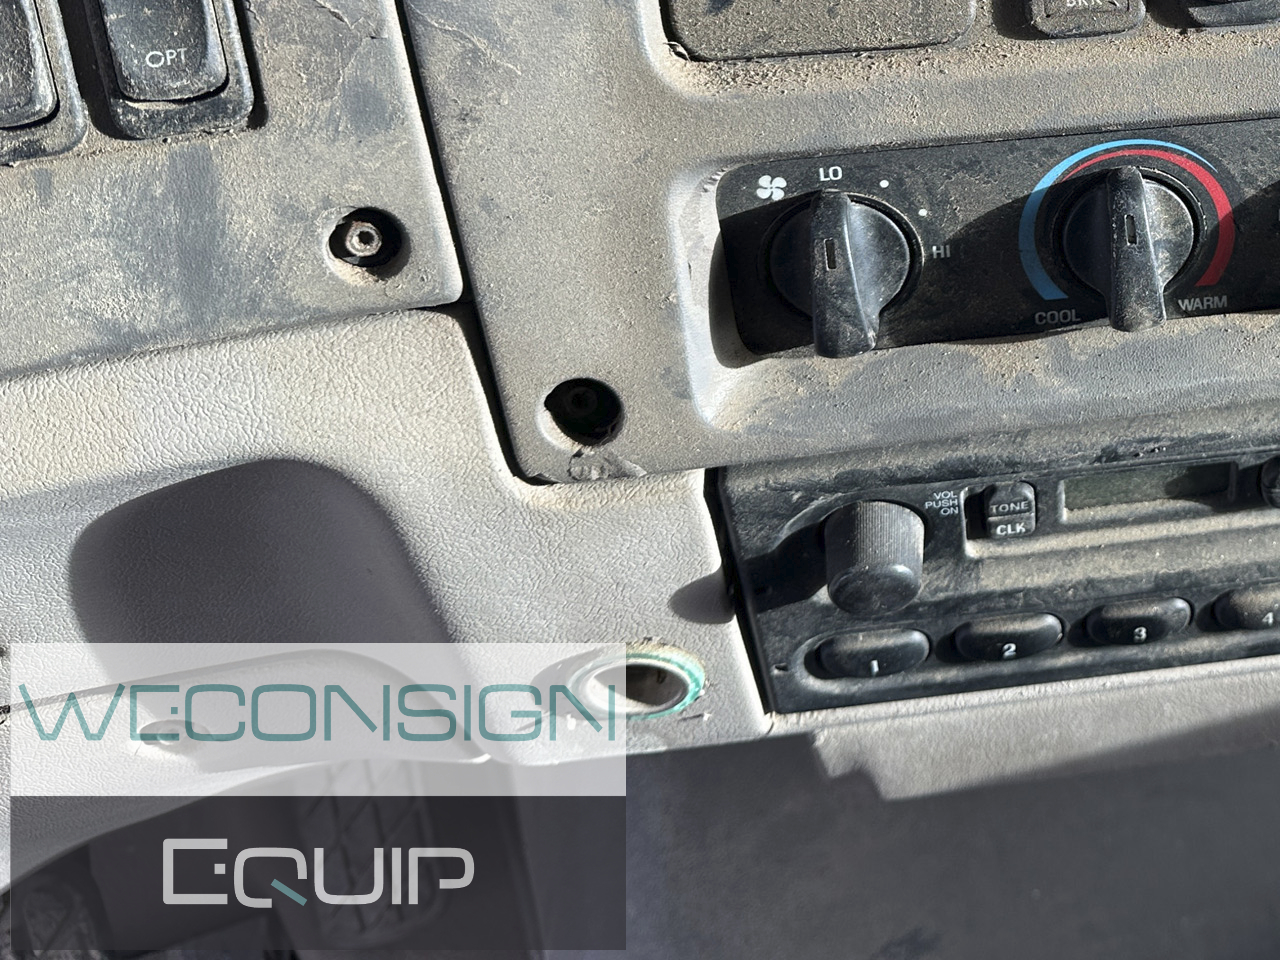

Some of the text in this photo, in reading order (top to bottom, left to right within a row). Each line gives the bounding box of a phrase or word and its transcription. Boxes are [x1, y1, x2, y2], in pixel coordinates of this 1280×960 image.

[145, 47, 188, 69] OPT
[819, 166, 843, 182] LO
[932, 245, 951, 259] HI
[1178, 295, 1229, 313] WARM
[1034, 308, 1081, 326] COOL
[933, 490, 958, 500] VOL
[925, 499, 958, 509] PUSH
[990, 501, 1029, 513] TONE
[941, 507, 959, 516] ON
[996, 522, 1026, 536] CLK
[1261, 612, 1274, 626] 4
[1133, 626, 1147, 641] 3
[1002, 643, 1017, 658] 2
[869, 659, 880, 677] 1
